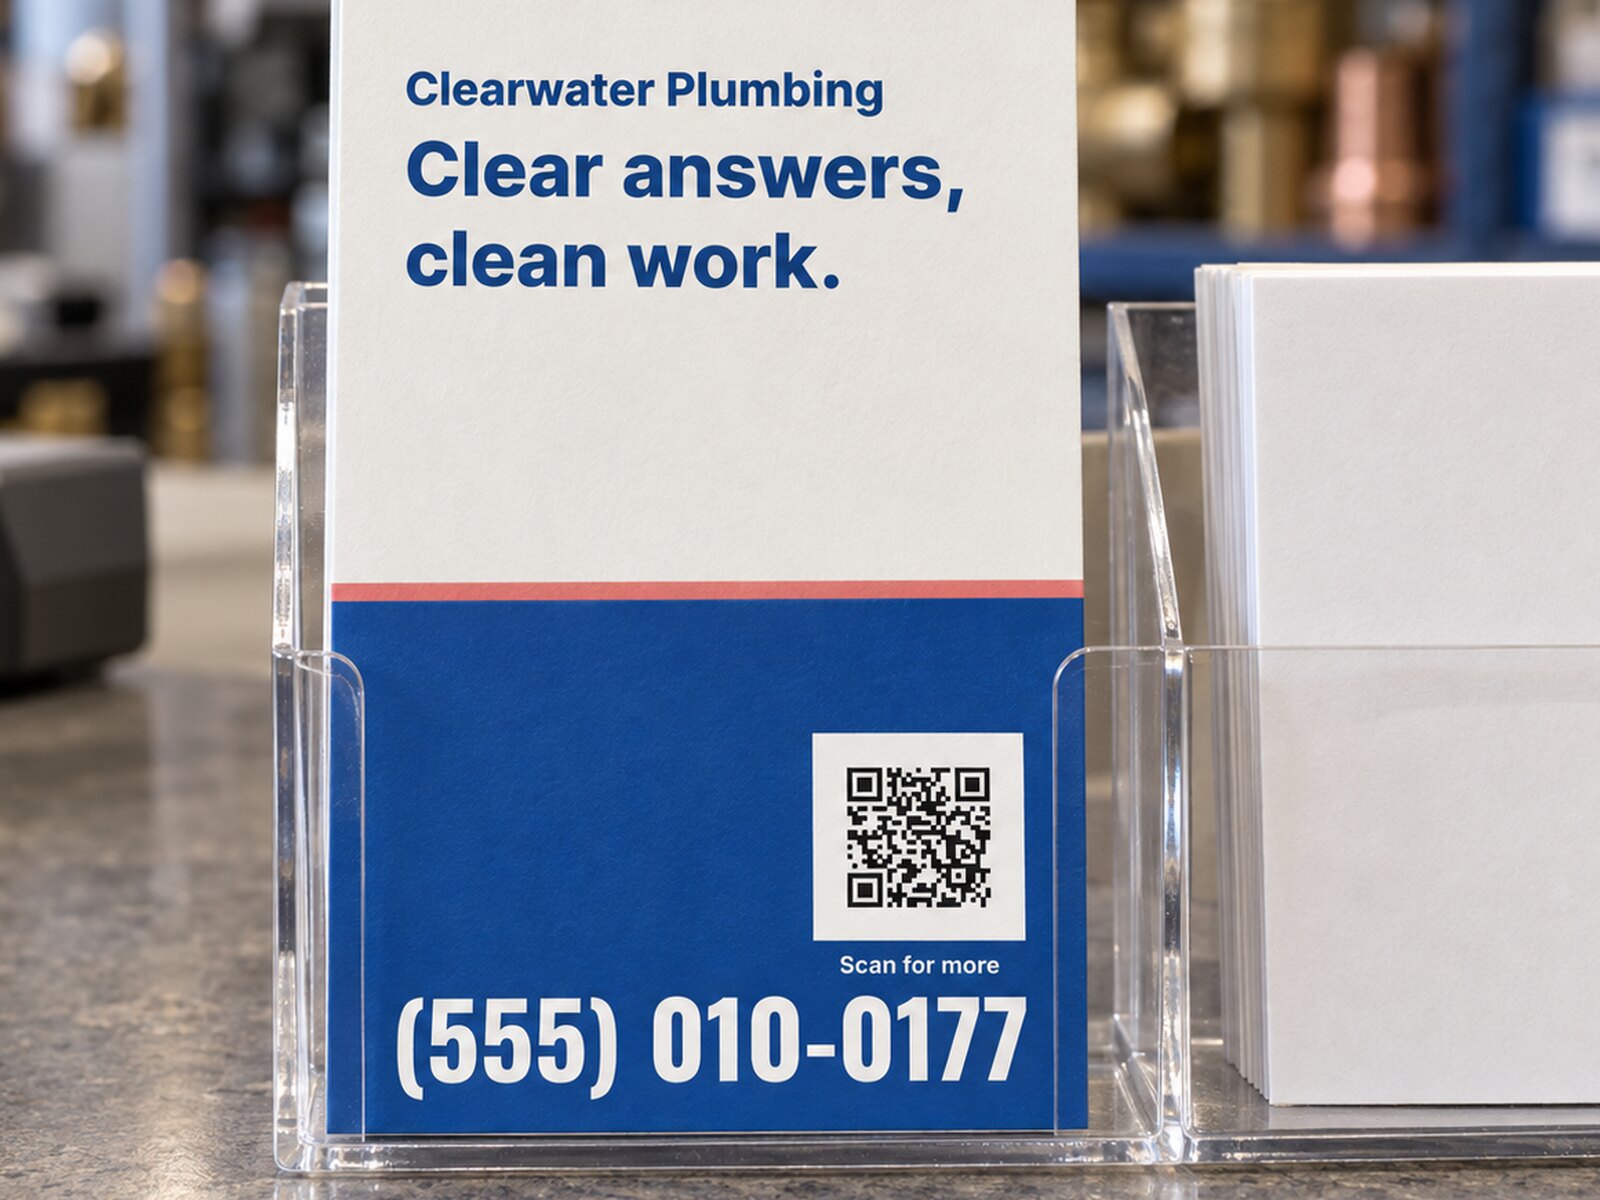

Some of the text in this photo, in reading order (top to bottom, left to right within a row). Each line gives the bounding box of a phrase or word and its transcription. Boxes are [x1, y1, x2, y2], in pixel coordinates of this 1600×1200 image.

[406, 70, 883, 117] Clearwater Plumbing
[407, 140, 964, 213] Clear answers,
[406, 230, 840, 290] clean work.
[839, 954, 1000, 975] Scan for more
[396, 995, 1027, 1101] (555) 010-0177
